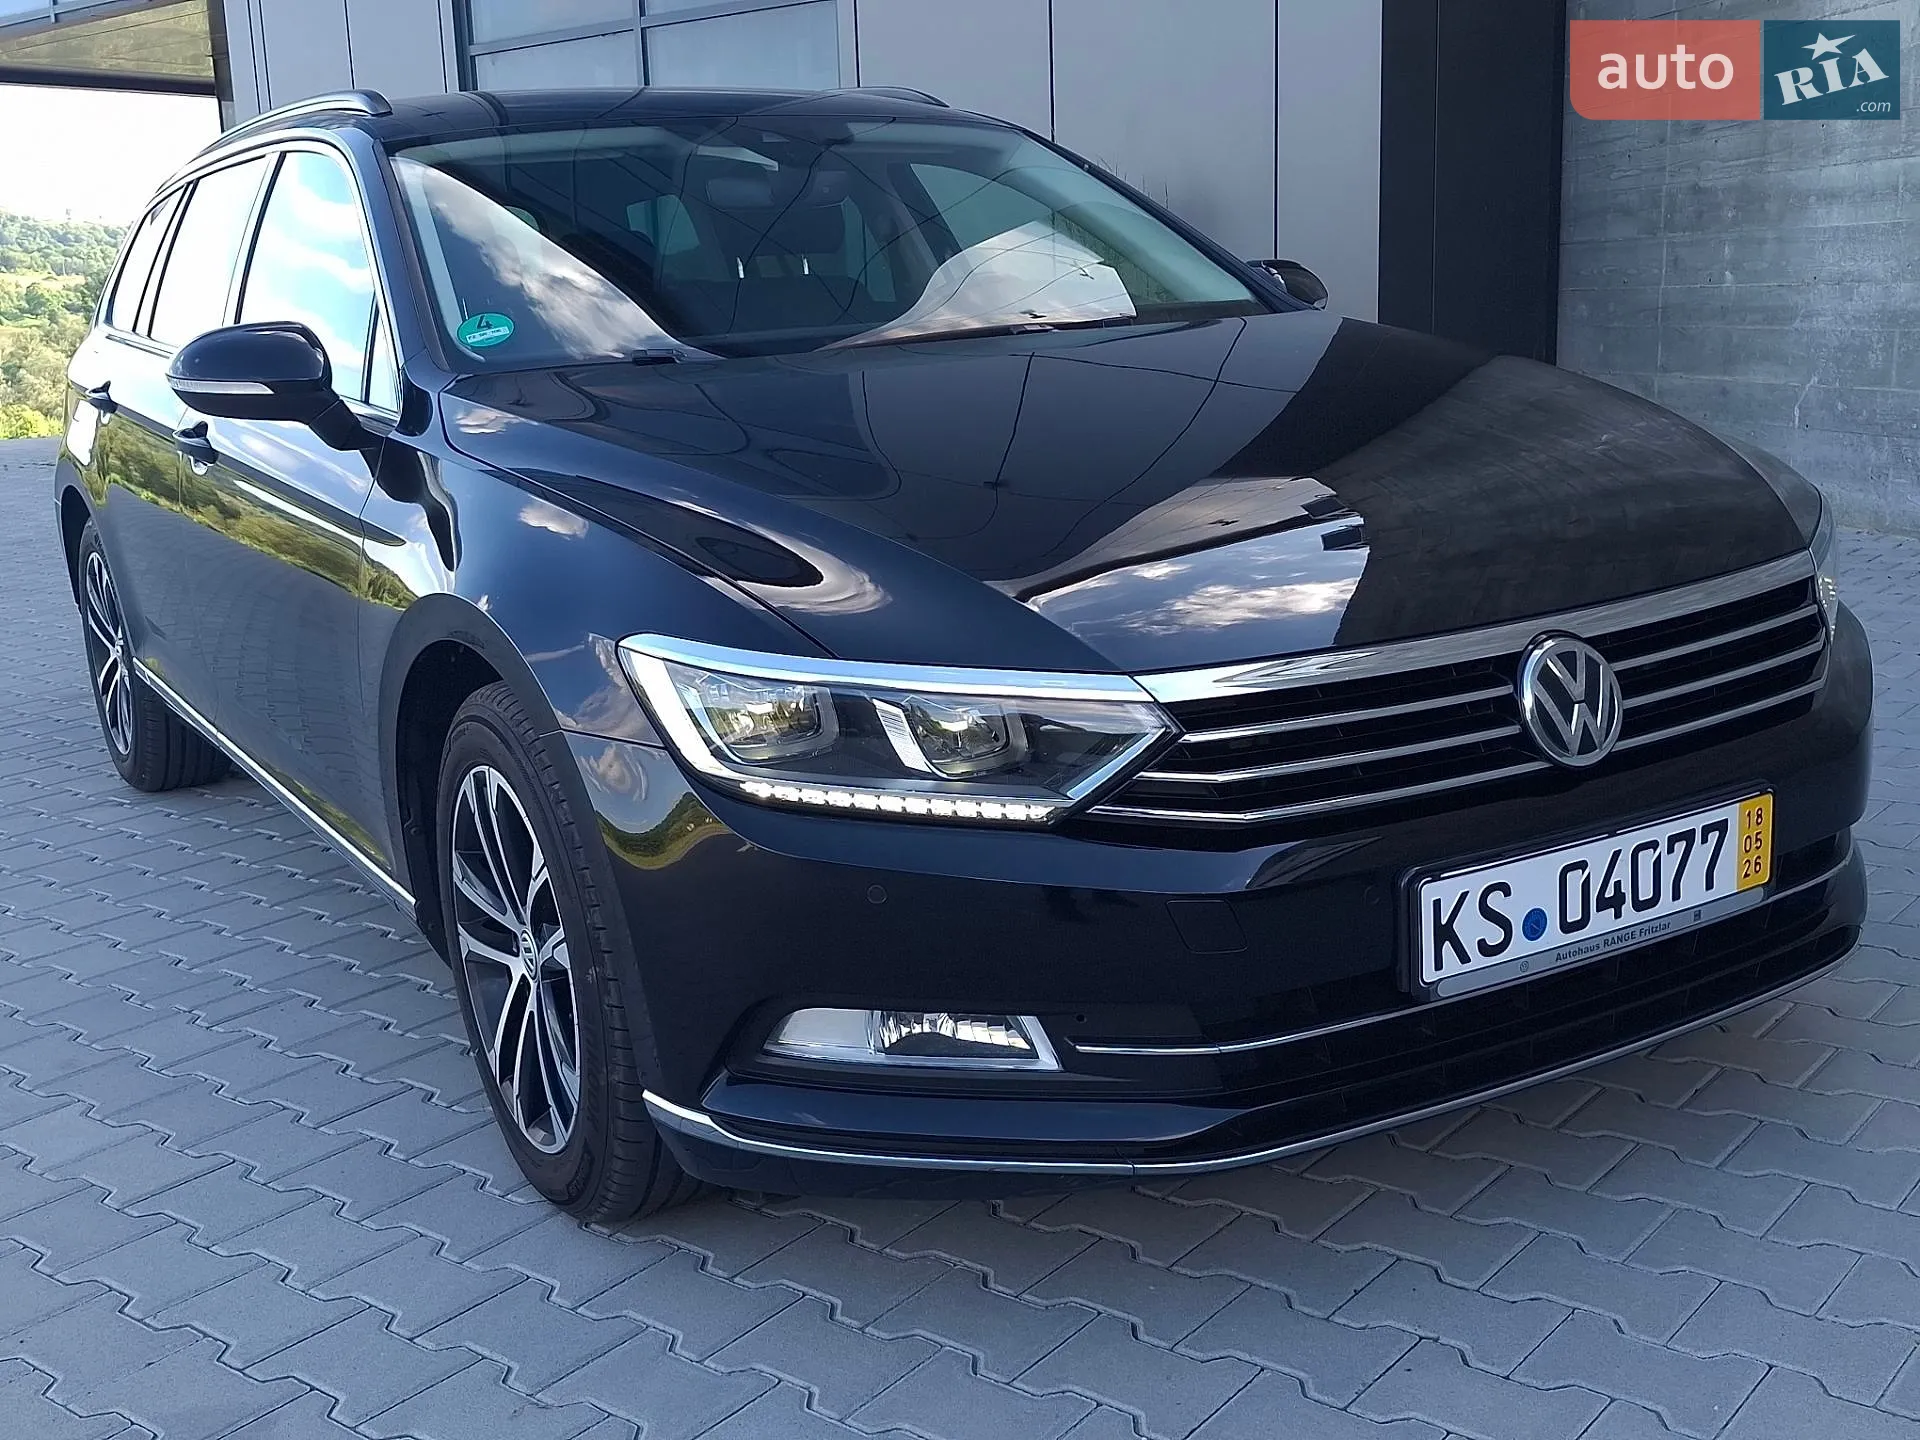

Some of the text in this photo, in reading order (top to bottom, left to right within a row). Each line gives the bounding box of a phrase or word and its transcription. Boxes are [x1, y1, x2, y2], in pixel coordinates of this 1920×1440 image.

[1746, 807, 1763, 829] 18
[1744, 831, 1763, 854] 05
[1742, 855, 1762, 879] 26
[1433, 817, 1729, 972] KS 04077
[1555, 921, 1671, 962] Autohaus RANGE Fritzlar
